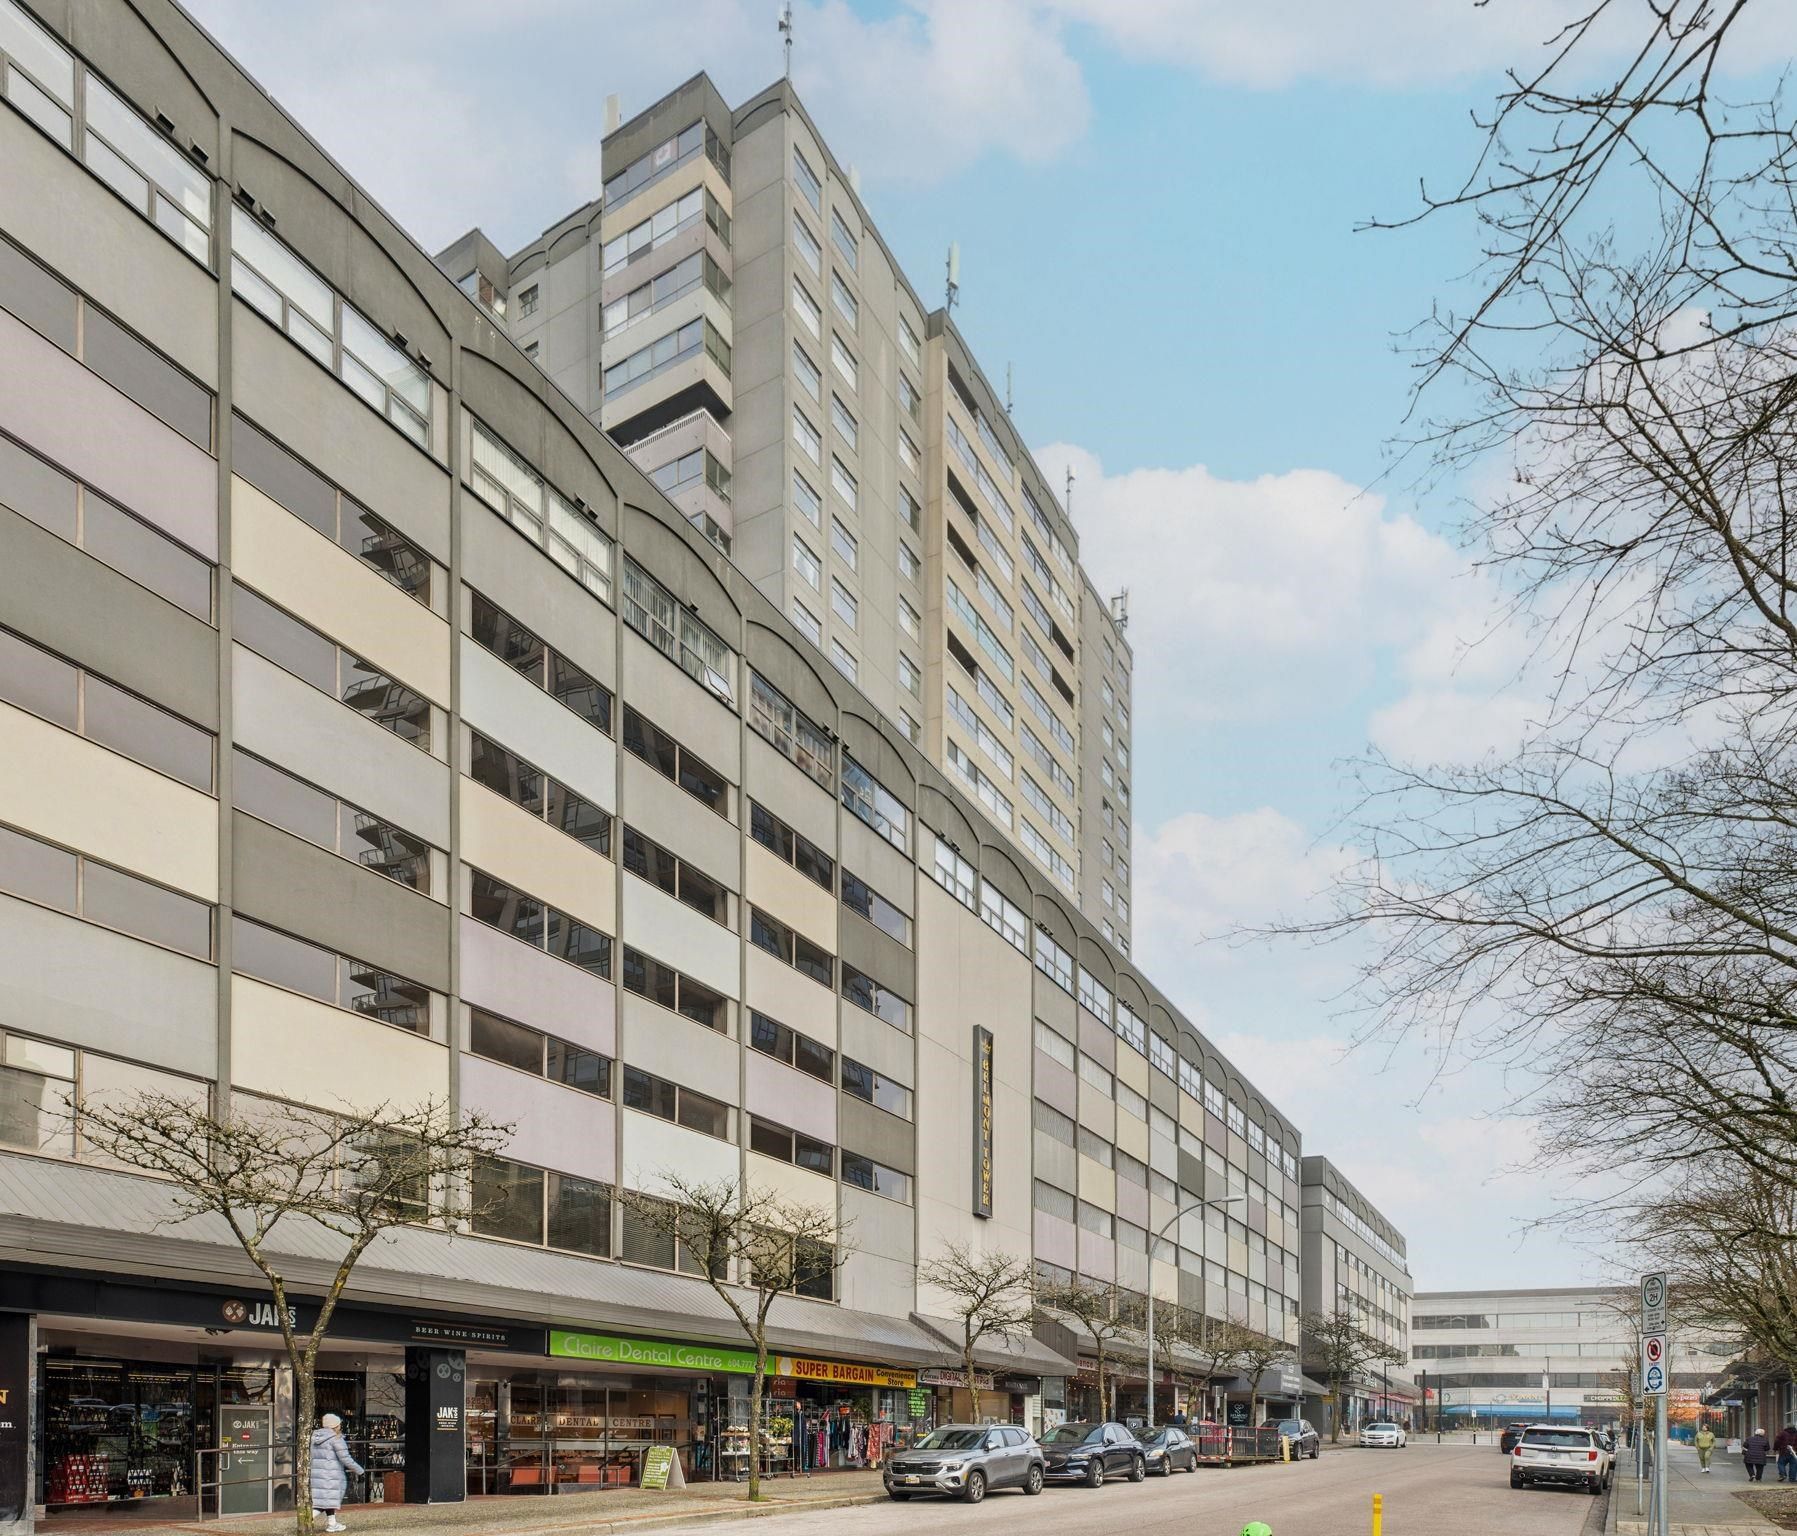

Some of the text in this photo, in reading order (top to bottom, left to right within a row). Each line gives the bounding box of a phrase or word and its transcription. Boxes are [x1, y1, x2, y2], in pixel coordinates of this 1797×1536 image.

[982, 1059, 991, 1206] BELMONT TOWER
[415, 1326, 506, 1341] BEER WINE SPIRITS
[564, 1336, 767, 1371] Claire Dental Centre 604.777.
[796, 1361, 874, 1382] SUPER BARGAIN
[876, 1369, 915, 1380] Convenience
[887, 1378, 904, 1386] Store
[510, 1416, 651, 1427] CLAIRE DENTAL CENTRE
